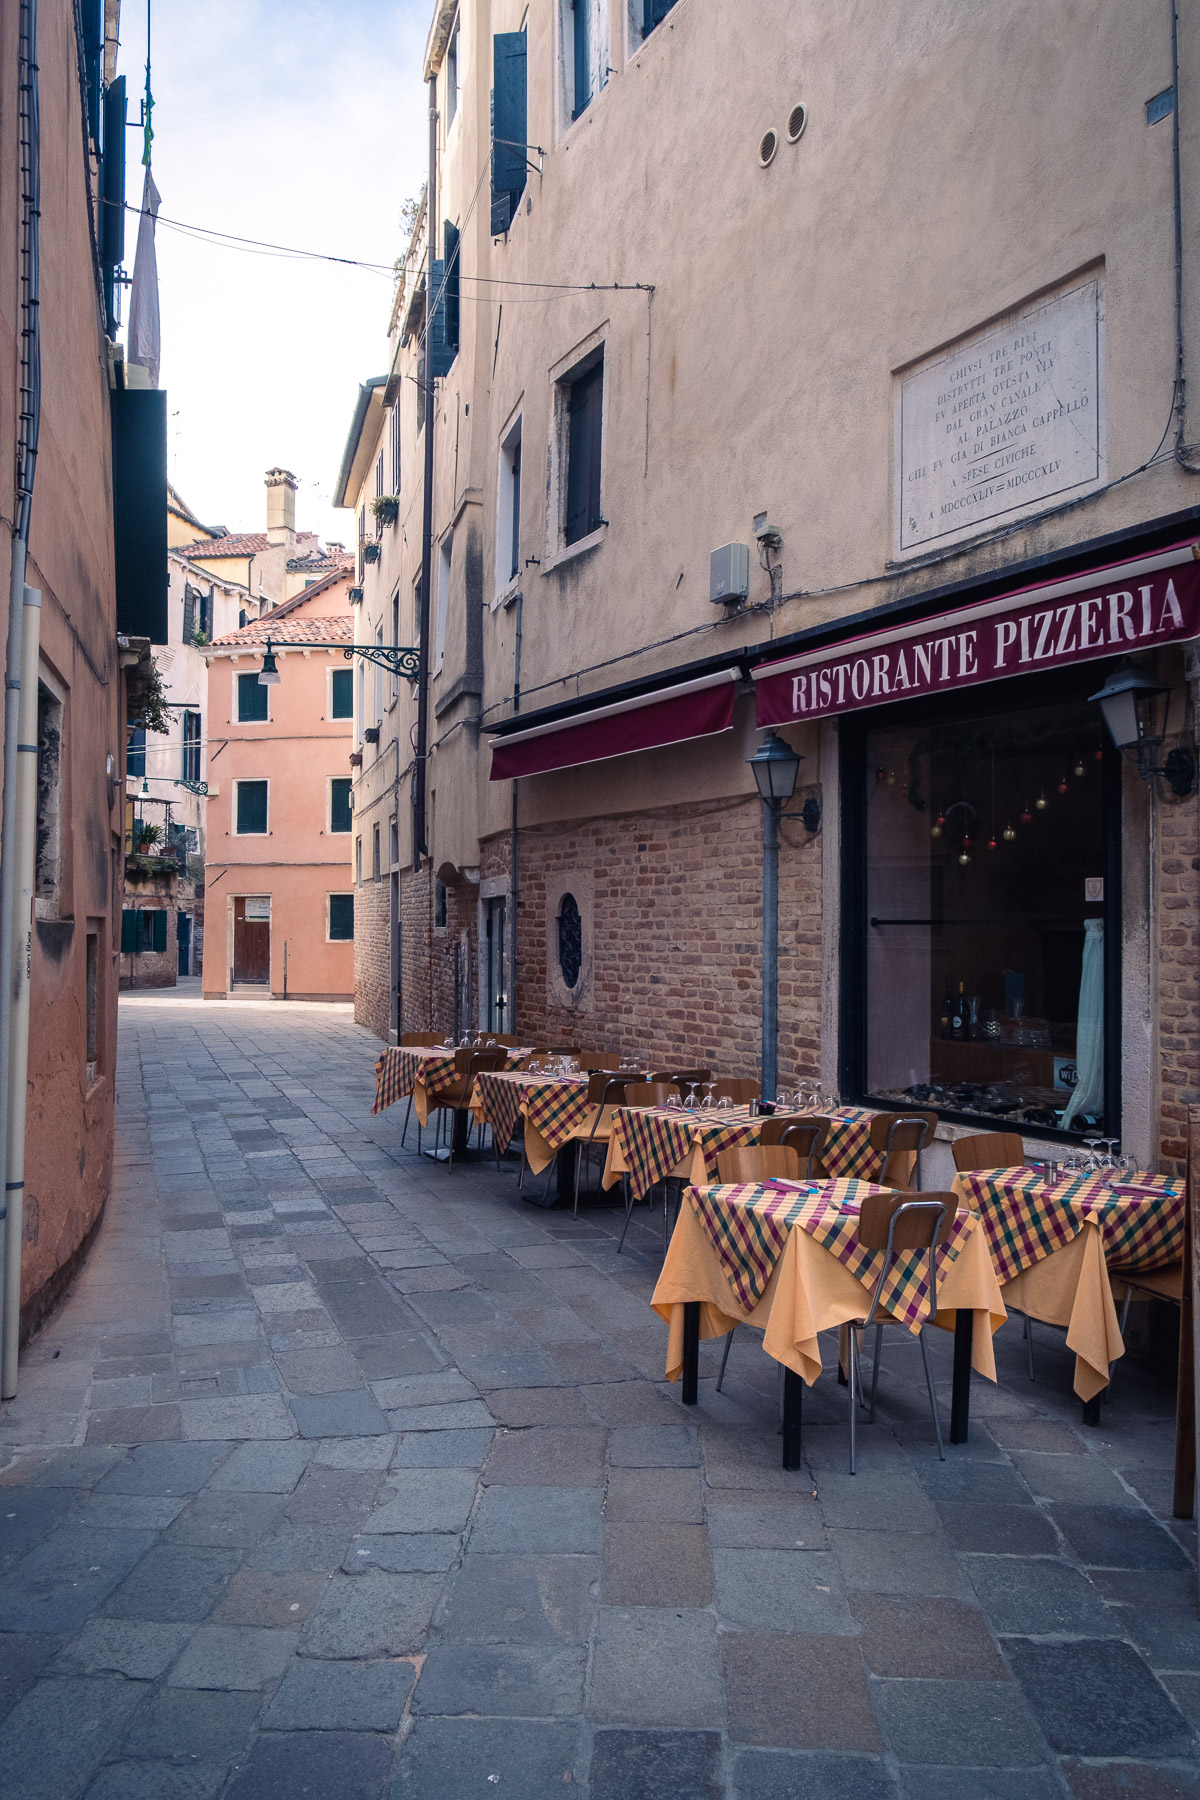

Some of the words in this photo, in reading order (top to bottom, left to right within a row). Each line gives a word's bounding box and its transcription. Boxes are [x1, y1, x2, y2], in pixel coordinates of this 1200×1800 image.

[988, 346, 1009, 363] TRE
[937, 373, 986, 406] DISTRVTTI
[993, 360, 1013, 378] TRE
[952, 391, 986, 415] APERTA
[992, 370, 1030, 396] QVESTA
[946, 418, 964, 434] DAL
[969, 402, 996, 422] GRAN
[1001, 382, 1041, 408] CANALE
[957, 432, 969, 445] AL
[976, 405, 1028, 437] PALAZZO
[908, 466, 928, 482] CHE
[973, 441, 984, 455] DI
[990, 423, 1027, 447] BIANCA
[1032, 395, 1089, 429] CAPPELLO
[962, 463, 989, 483] SPESE
[994, 443, 1037, 470] CIVICHE
[928, 511, 934, 521] A
[791, 630, 978, 714] RISTORANTE
[993, 578, 1185, 669] PIZZERIA
